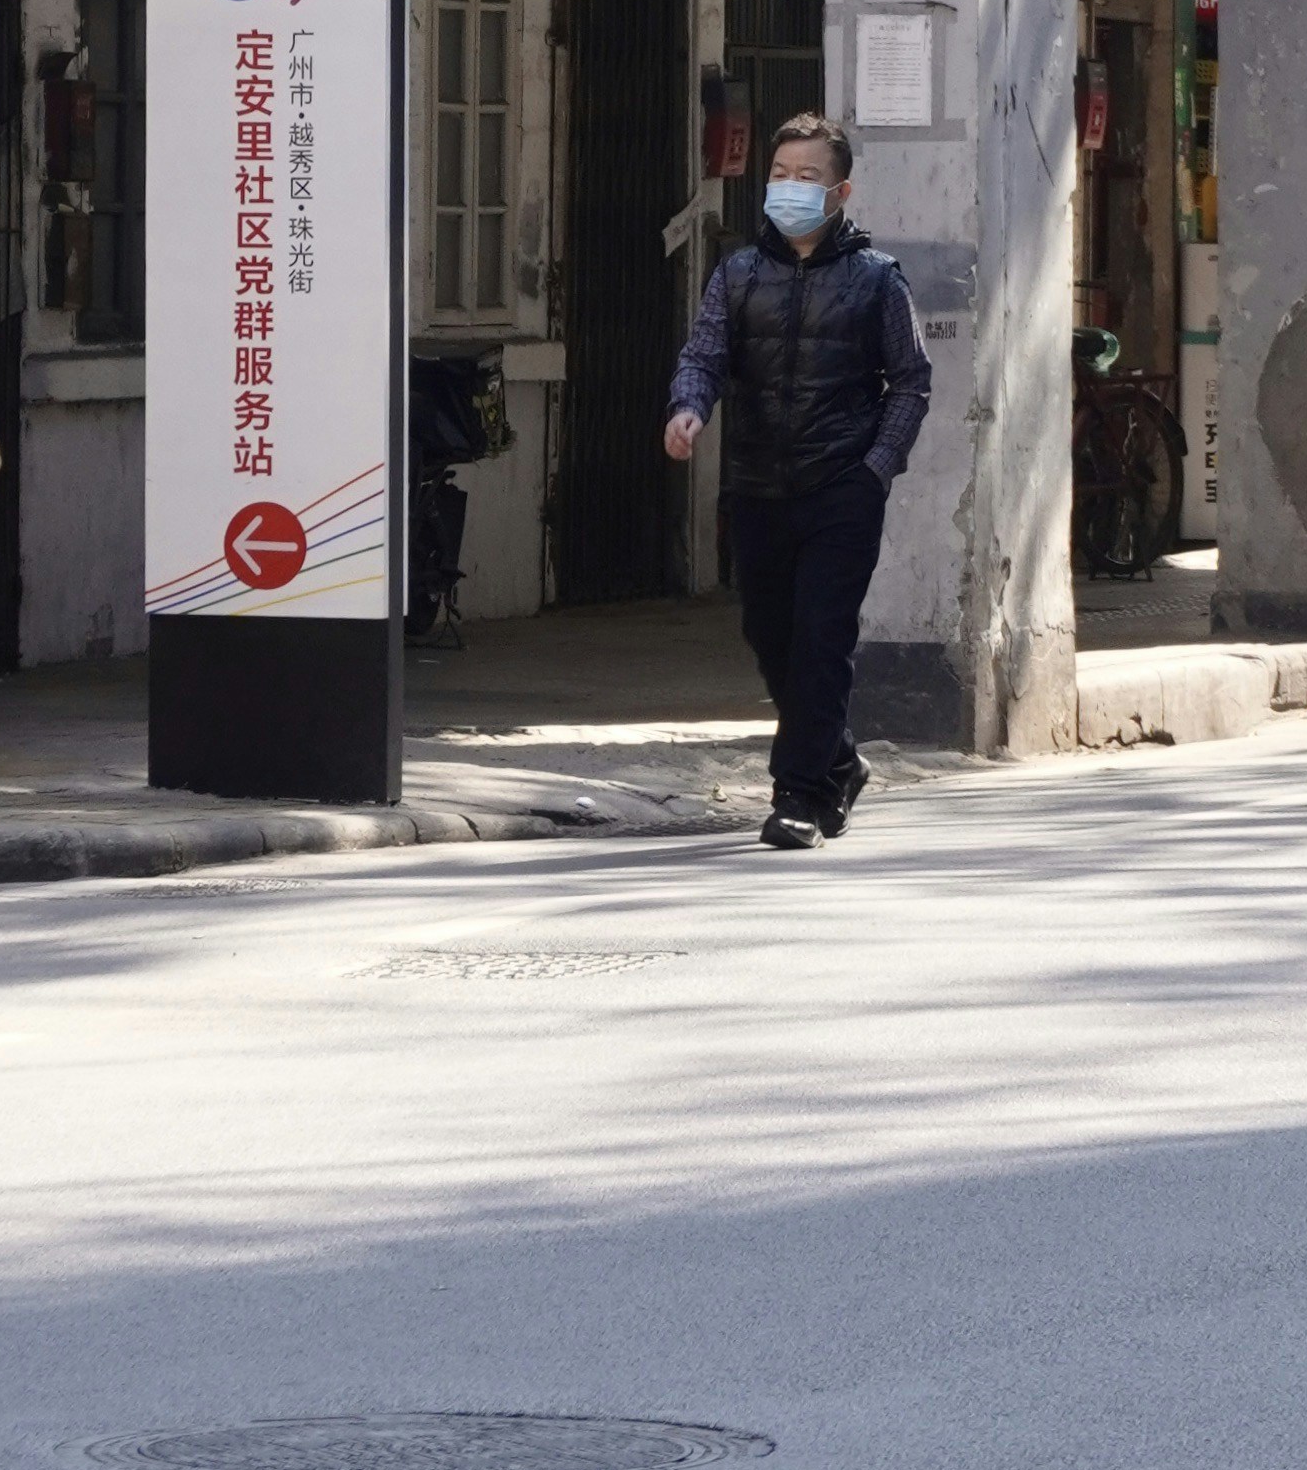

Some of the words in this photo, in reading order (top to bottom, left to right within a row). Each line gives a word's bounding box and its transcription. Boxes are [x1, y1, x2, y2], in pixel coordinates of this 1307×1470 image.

[232, 28, 275, 478] 定安里社区党群服务站
